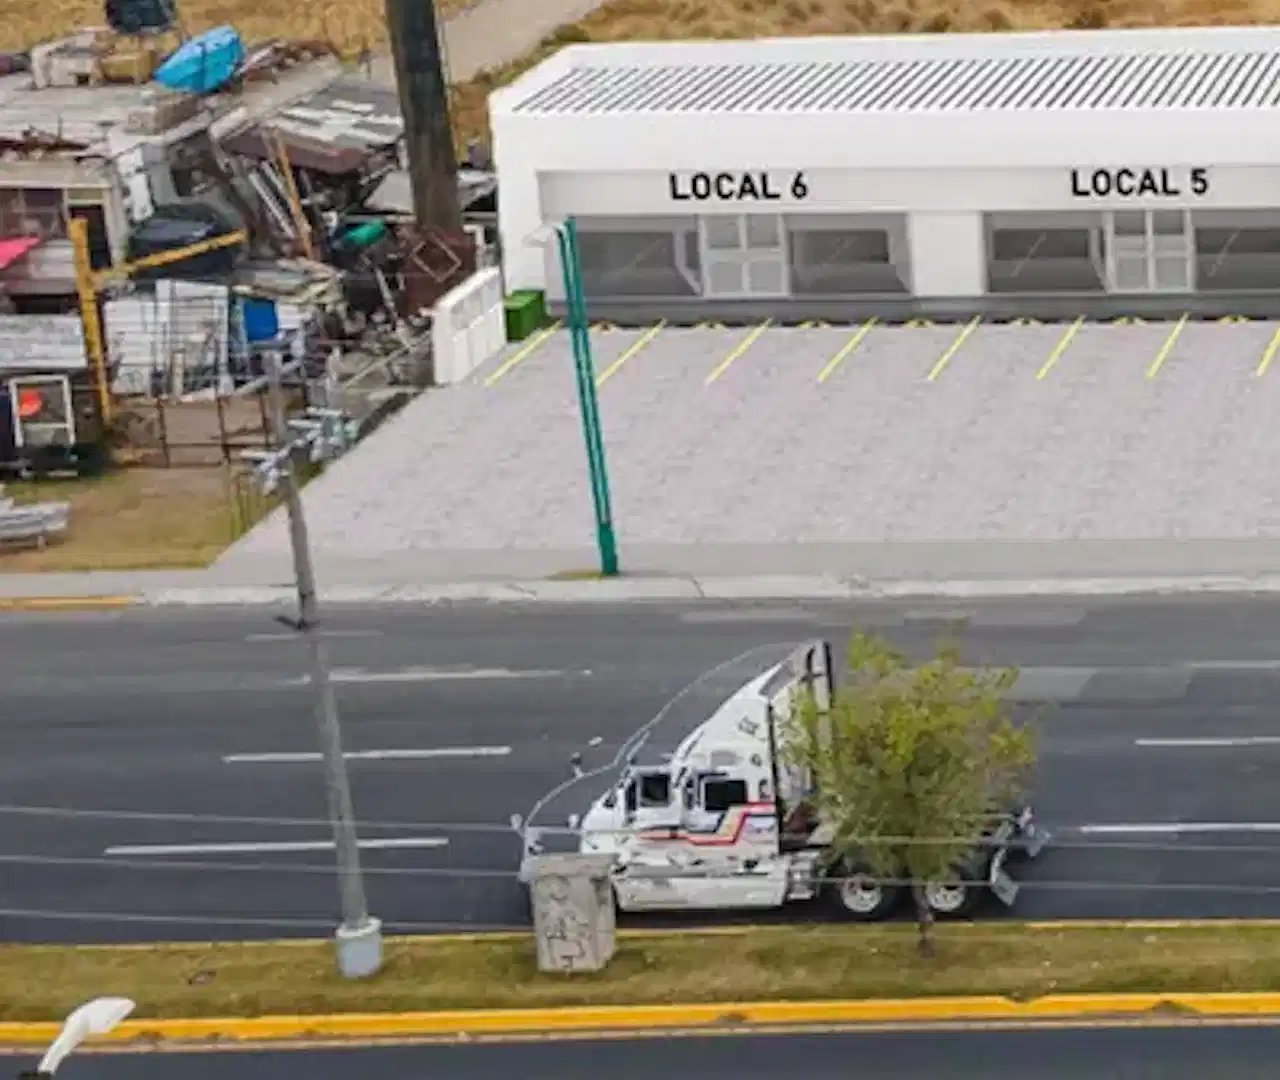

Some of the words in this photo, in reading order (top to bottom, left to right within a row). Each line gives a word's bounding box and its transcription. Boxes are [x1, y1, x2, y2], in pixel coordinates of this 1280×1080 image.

[669, 172, 781, 201] LOCAL
[791, 171, 808, 200] 6
[1071, 168, 1181, 197] LOCAL
[1191, 167, 1208, 195] 5
